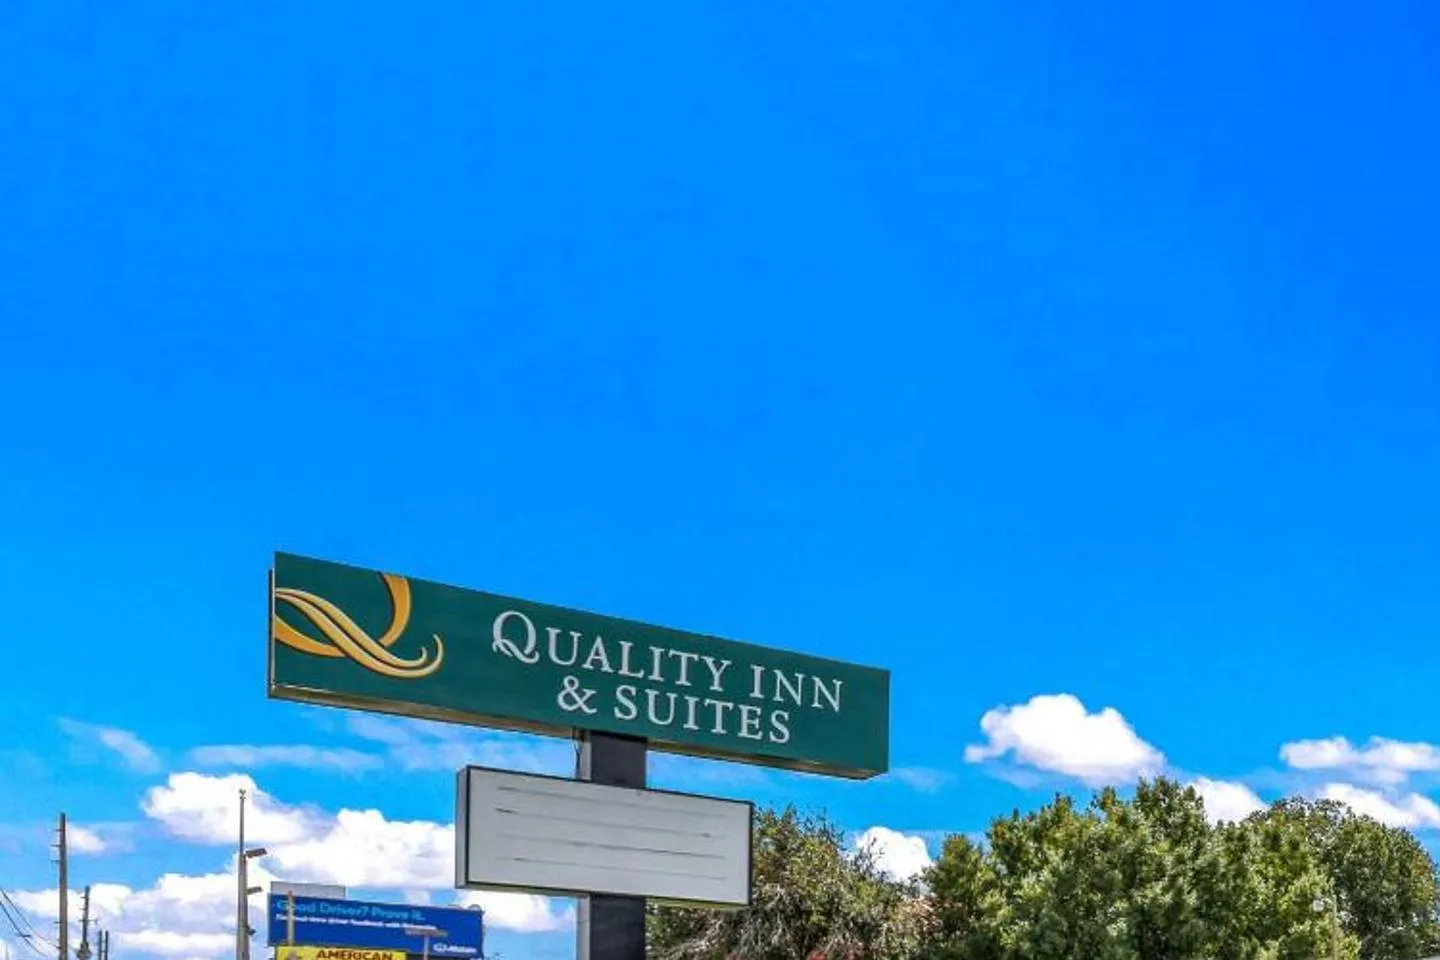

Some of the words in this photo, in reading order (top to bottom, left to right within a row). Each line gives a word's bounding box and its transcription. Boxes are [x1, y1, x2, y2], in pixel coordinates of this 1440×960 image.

[492, 610, 732, 692] QUALITY
[749, 664, 843, 713] INN
[556, 675, 598, 715] &
[613, 685, 791, 744] SUITES
[276, 900, 317, 913] God
